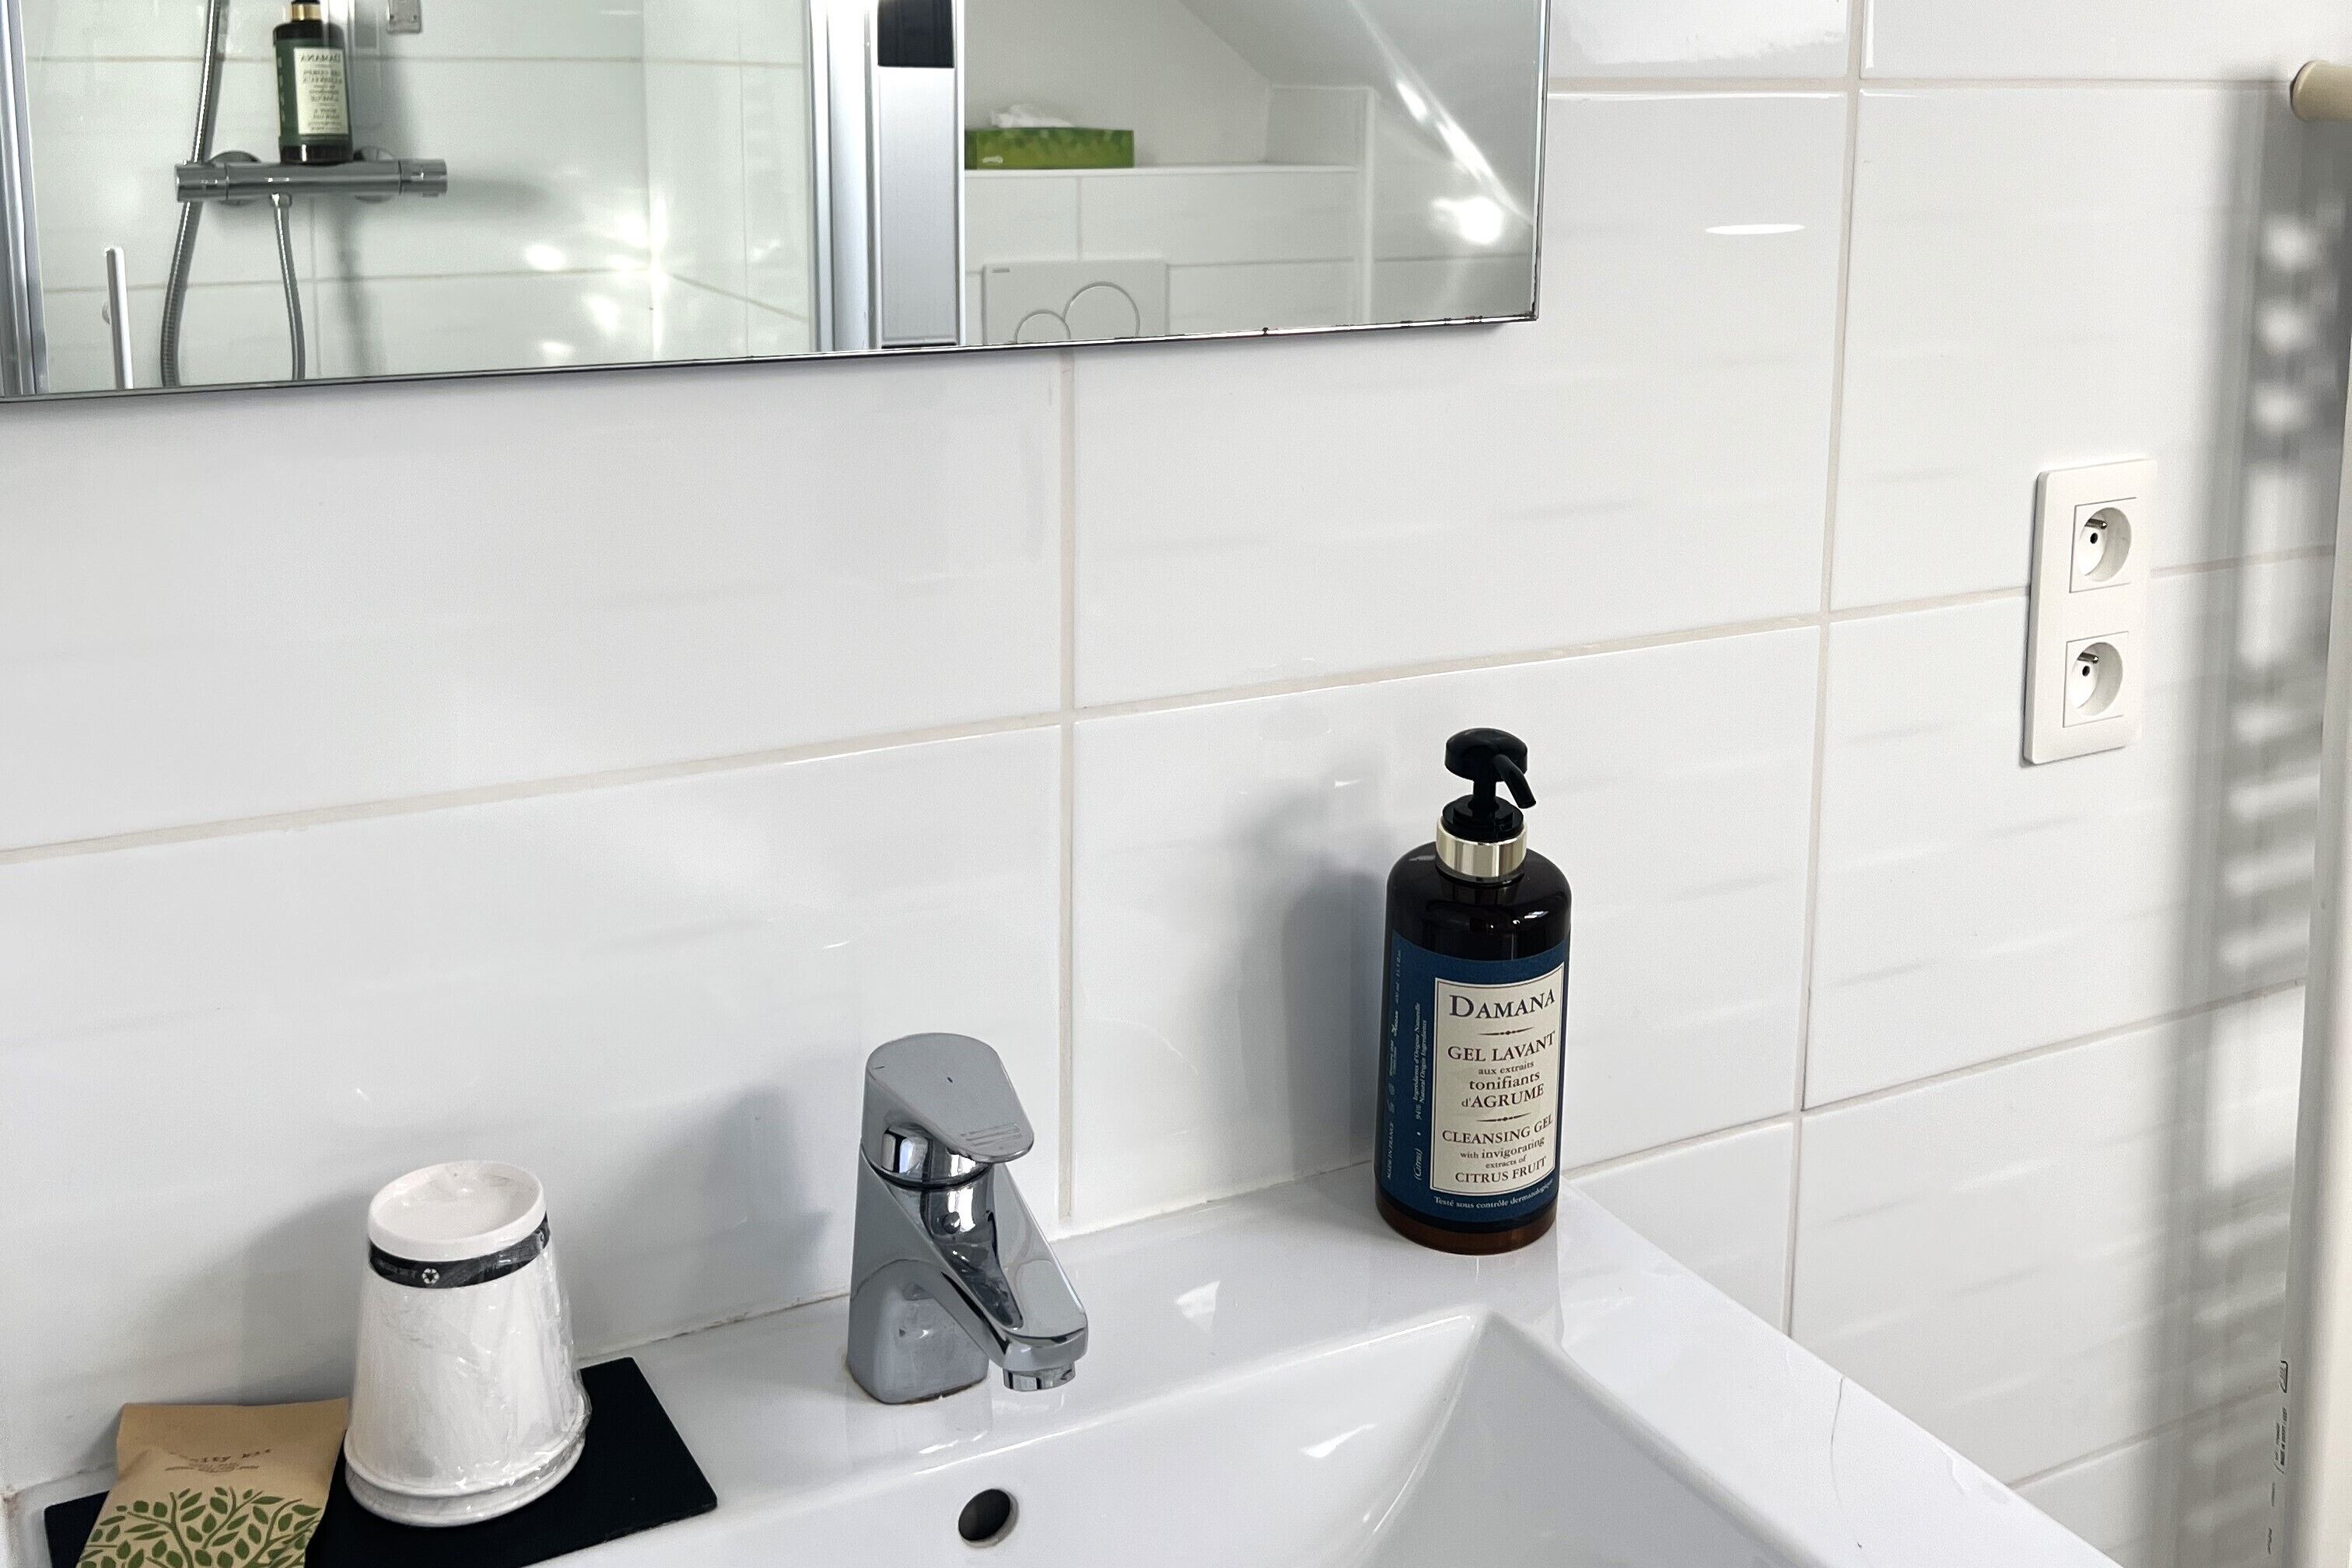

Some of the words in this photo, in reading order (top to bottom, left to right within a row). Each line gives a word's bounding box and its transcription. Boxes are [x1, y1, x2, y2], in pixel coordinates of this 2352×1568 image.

[1449, 989, 1556, 1019] DAMANA
[1447, 1045, 1486, 1062] GEL
[1492, 1030, 1556, 1062] LAVANT
[1500, 1060, 1535, 1074] extraits
[1469, 1071, 1540, 1090] tonifiants
[1461, 1083, 1545, 1108] d'AGRUME
[1442, 1126, 1531, 1144] CLEANSING
[1534, 1114, 1553, 1133] GEL
[1482, 1136, 1545, 1159] invigorating
[1455, 1171, 1509, 1183] CITRUS
[1512, 1156, 1547, 1179] FRUIT
[1485, 1159, 1517, 1169] extracts
[1518, 1154, 1528, 1164] of
[1433, 1196, 1454, 1207] Testé
[1475, 1199, 1509, 1209] contrôle
